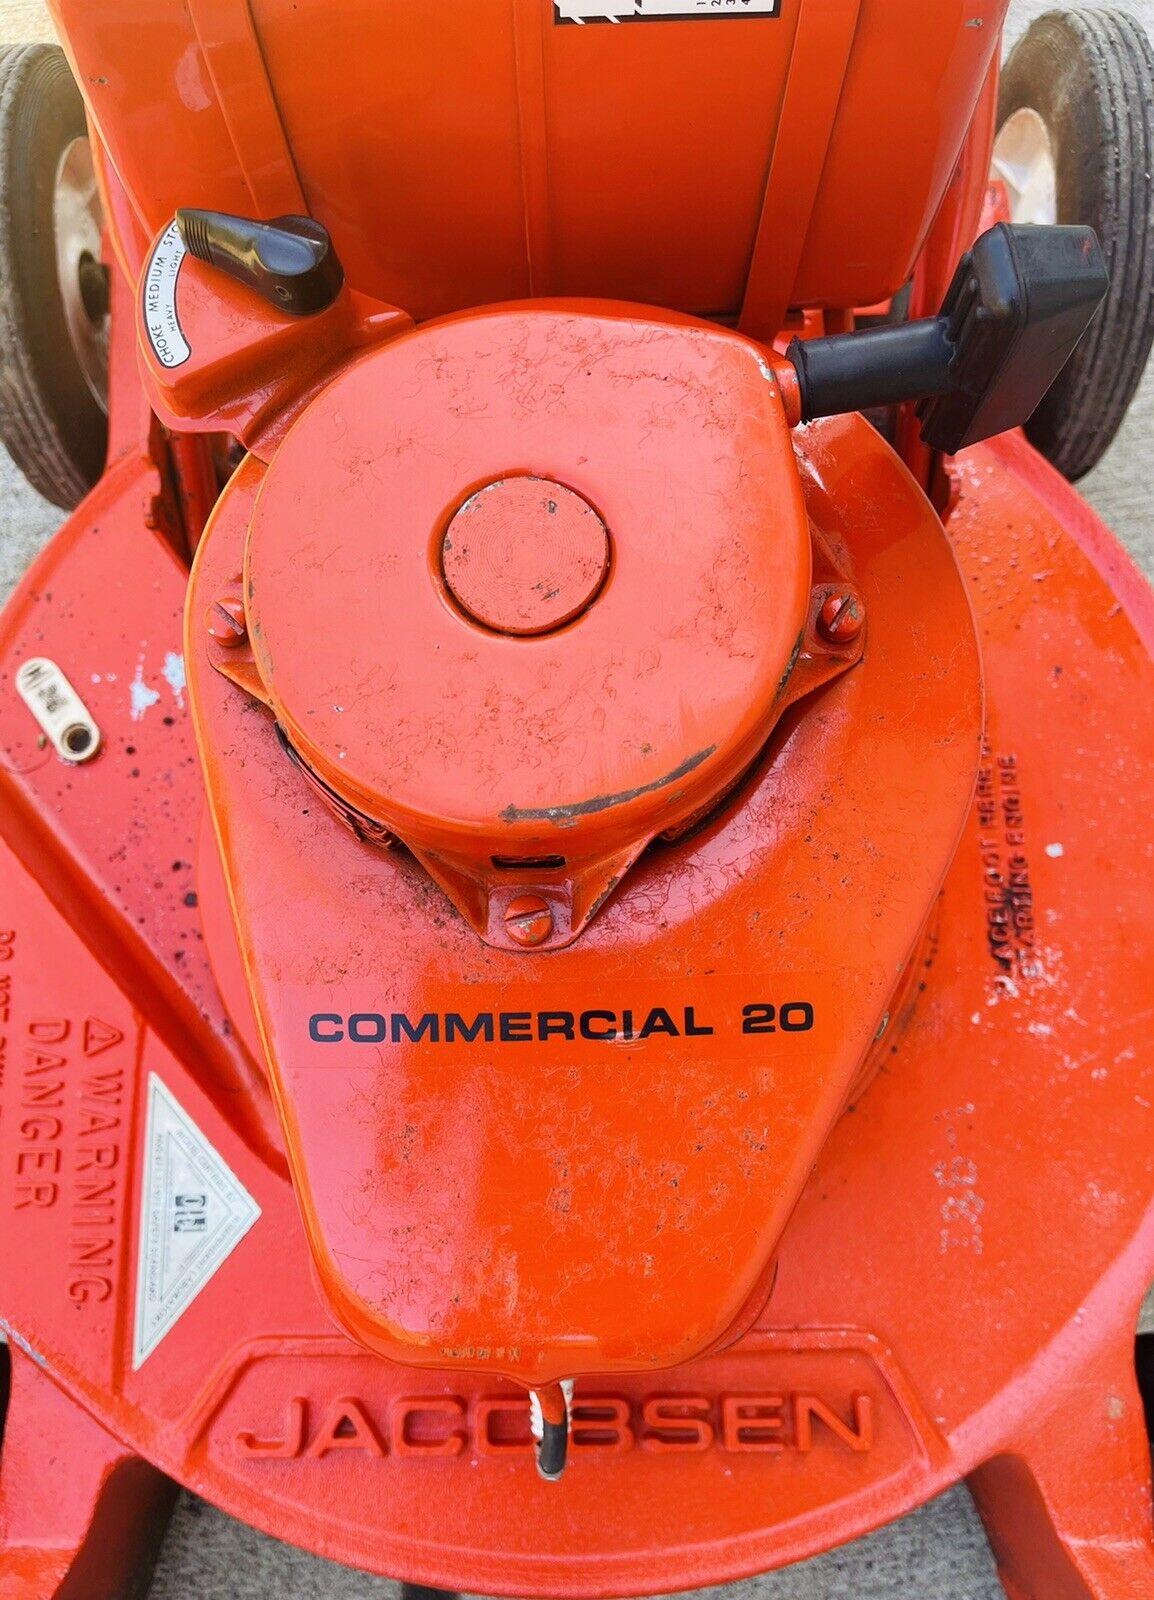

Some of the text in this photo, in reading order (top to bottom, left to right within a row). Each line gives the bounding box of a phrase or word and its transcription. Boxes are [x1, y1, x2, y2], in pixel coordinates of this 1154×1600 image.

[148, 223, 179, 363] CHOKE MEDIUM STO
[164, 249, 183, 332] HEAVY LIGHT
[308, 1001, 815, 1042] COMMERCIAL 20
[14, 1017, 72, 1211] DANGER
[68, 1068, 124, 1303] WARNING
[236, 1393, 873, 1458] JACOBSEN
